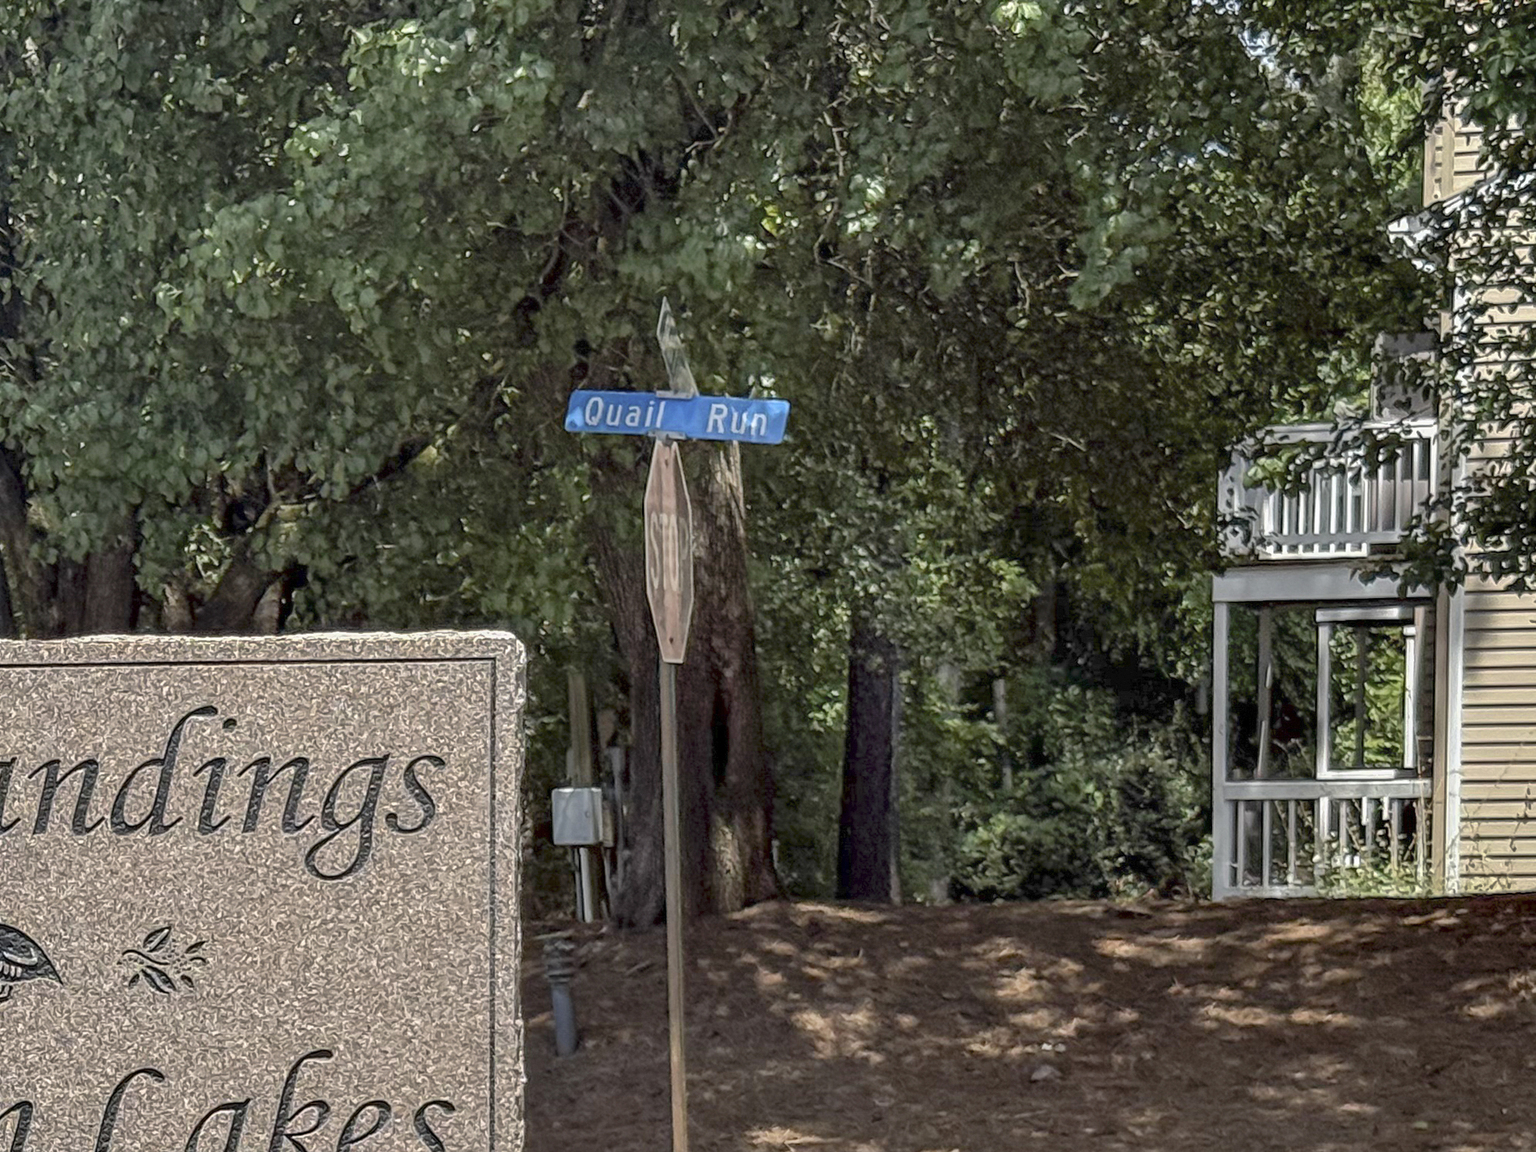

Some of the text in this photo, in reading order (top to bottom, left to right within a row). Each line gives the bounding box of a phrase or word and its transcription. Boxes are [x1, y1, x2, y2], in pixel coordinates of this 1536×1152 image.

[584, 396, 768, 436] Quail Run
[650, 511, 689, 592] STOP
